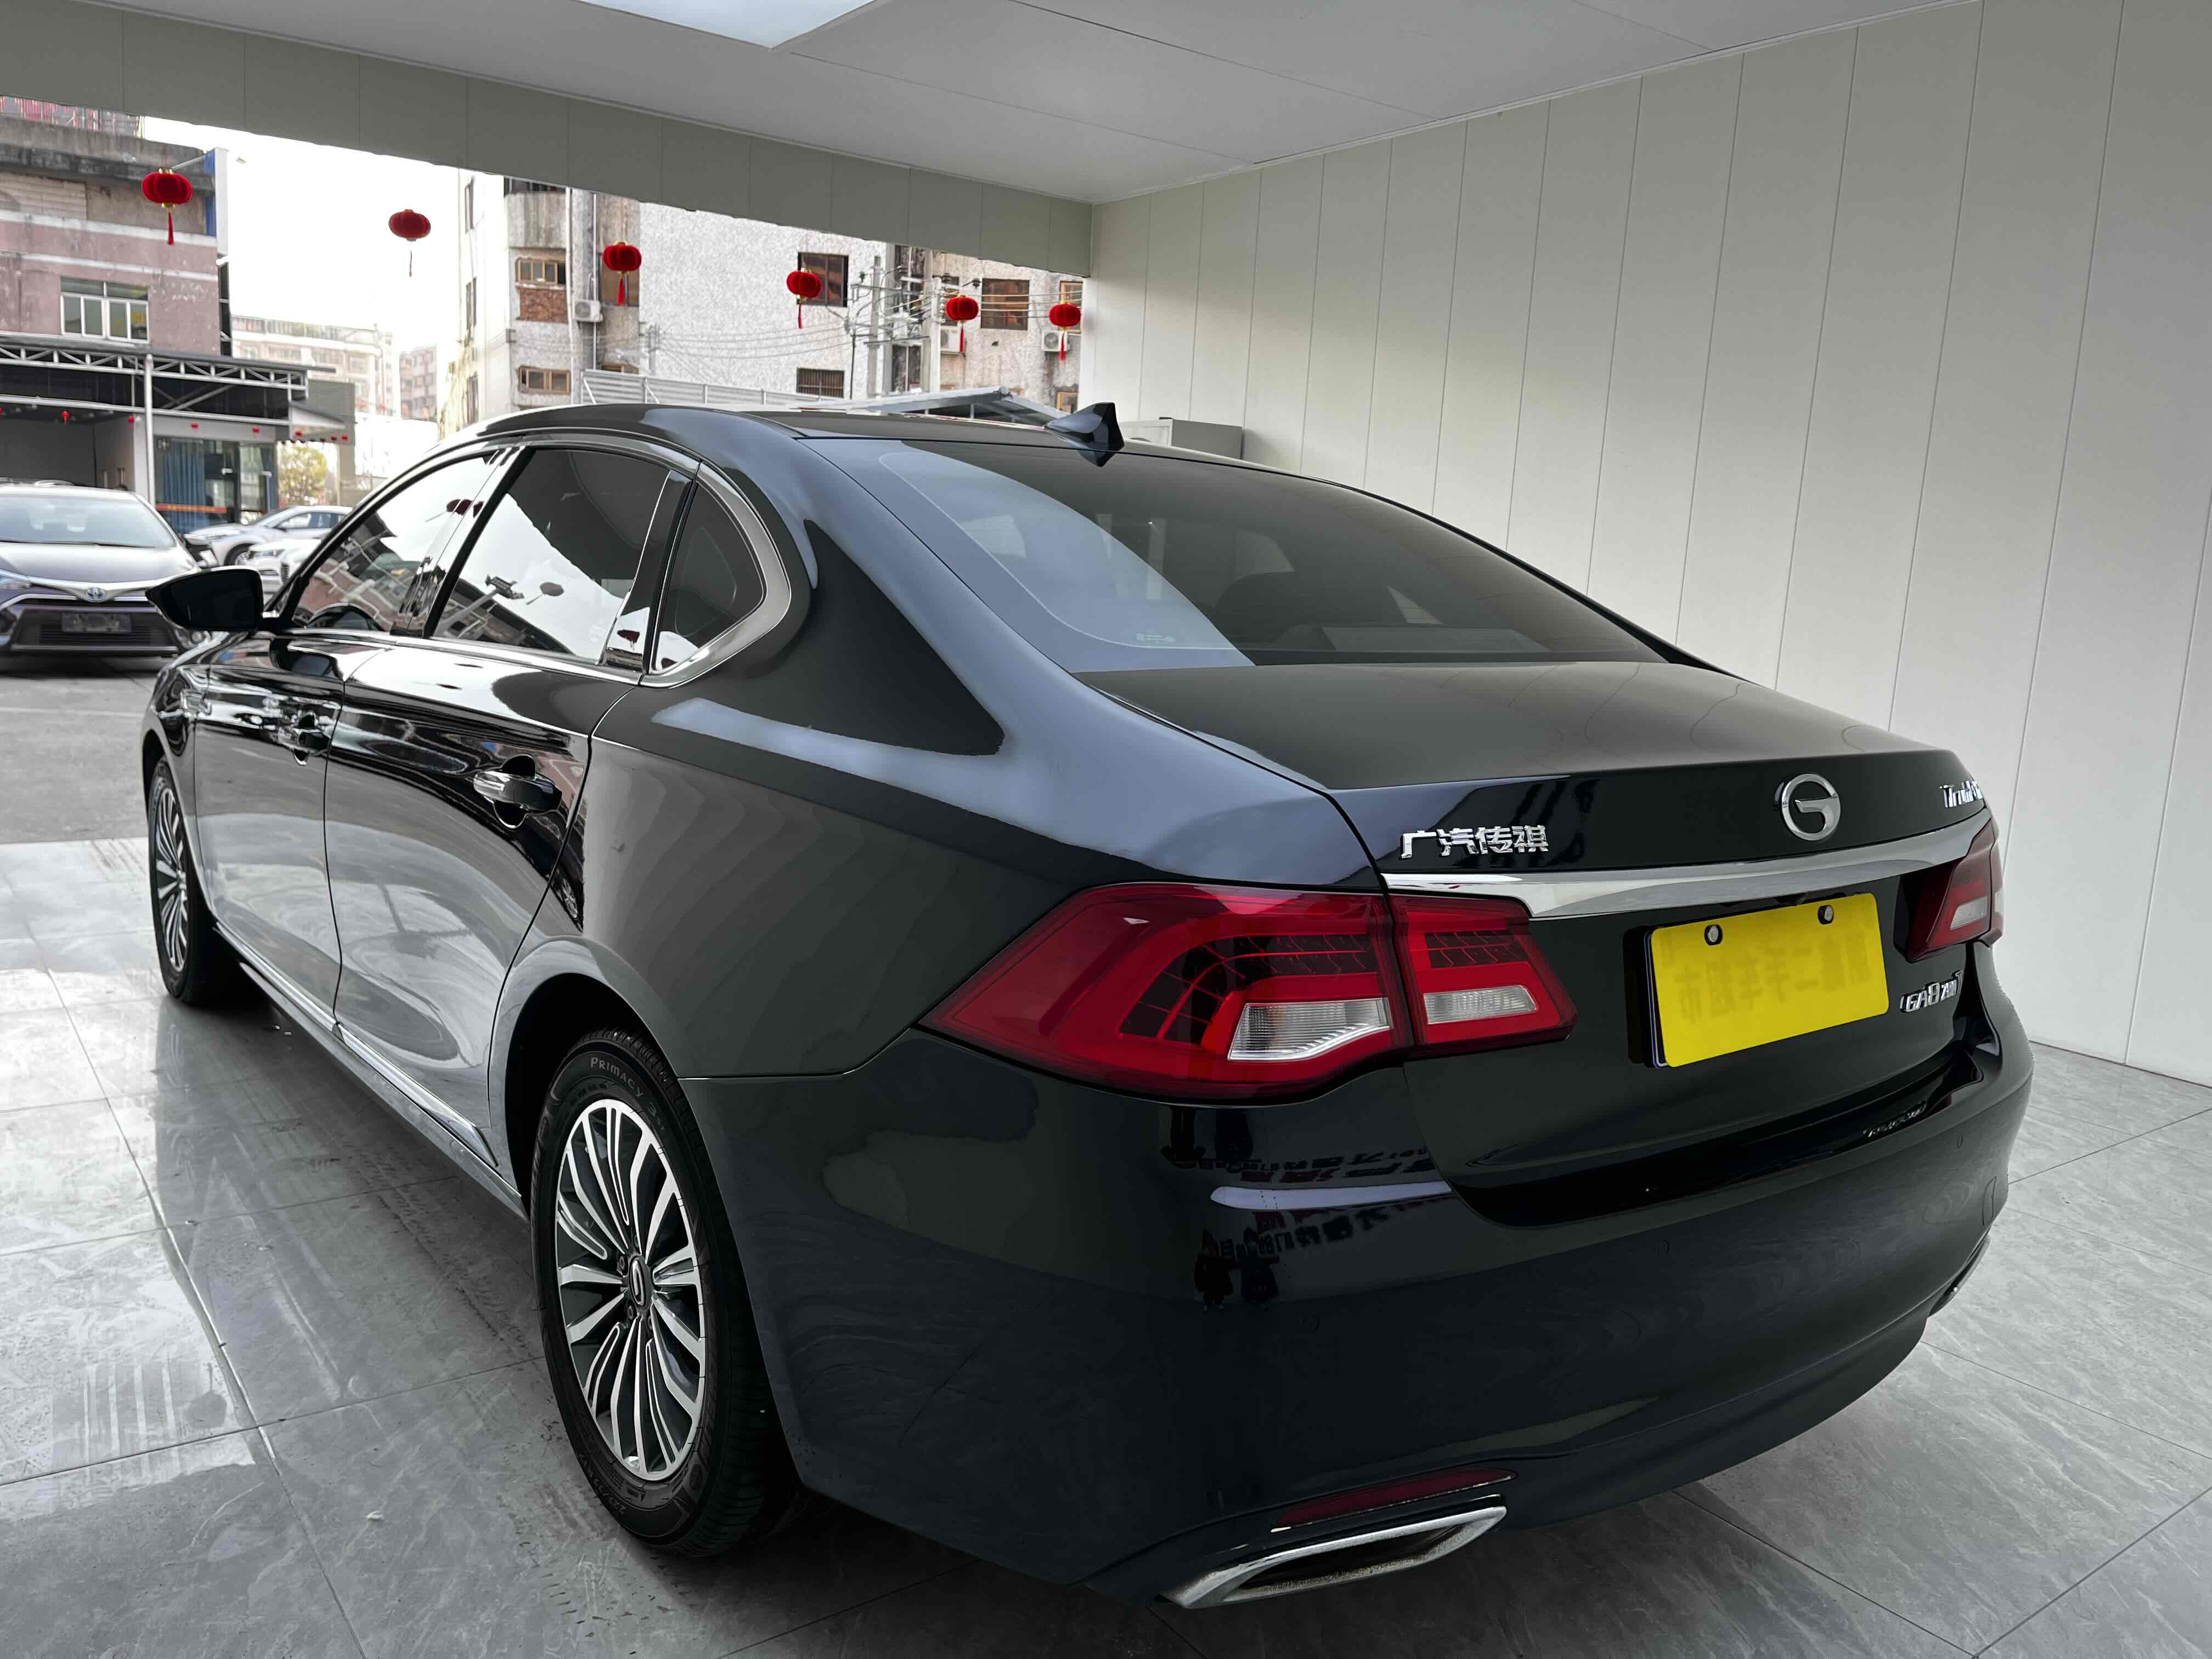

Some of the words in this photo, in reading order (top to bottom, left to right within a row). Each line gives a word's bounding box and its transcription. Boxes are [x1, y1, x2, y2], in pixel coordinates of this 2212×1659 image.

[1401, 825, 1549, 858] 广汽传祺
[590, 1057, 644, 1097] PRIMACY
